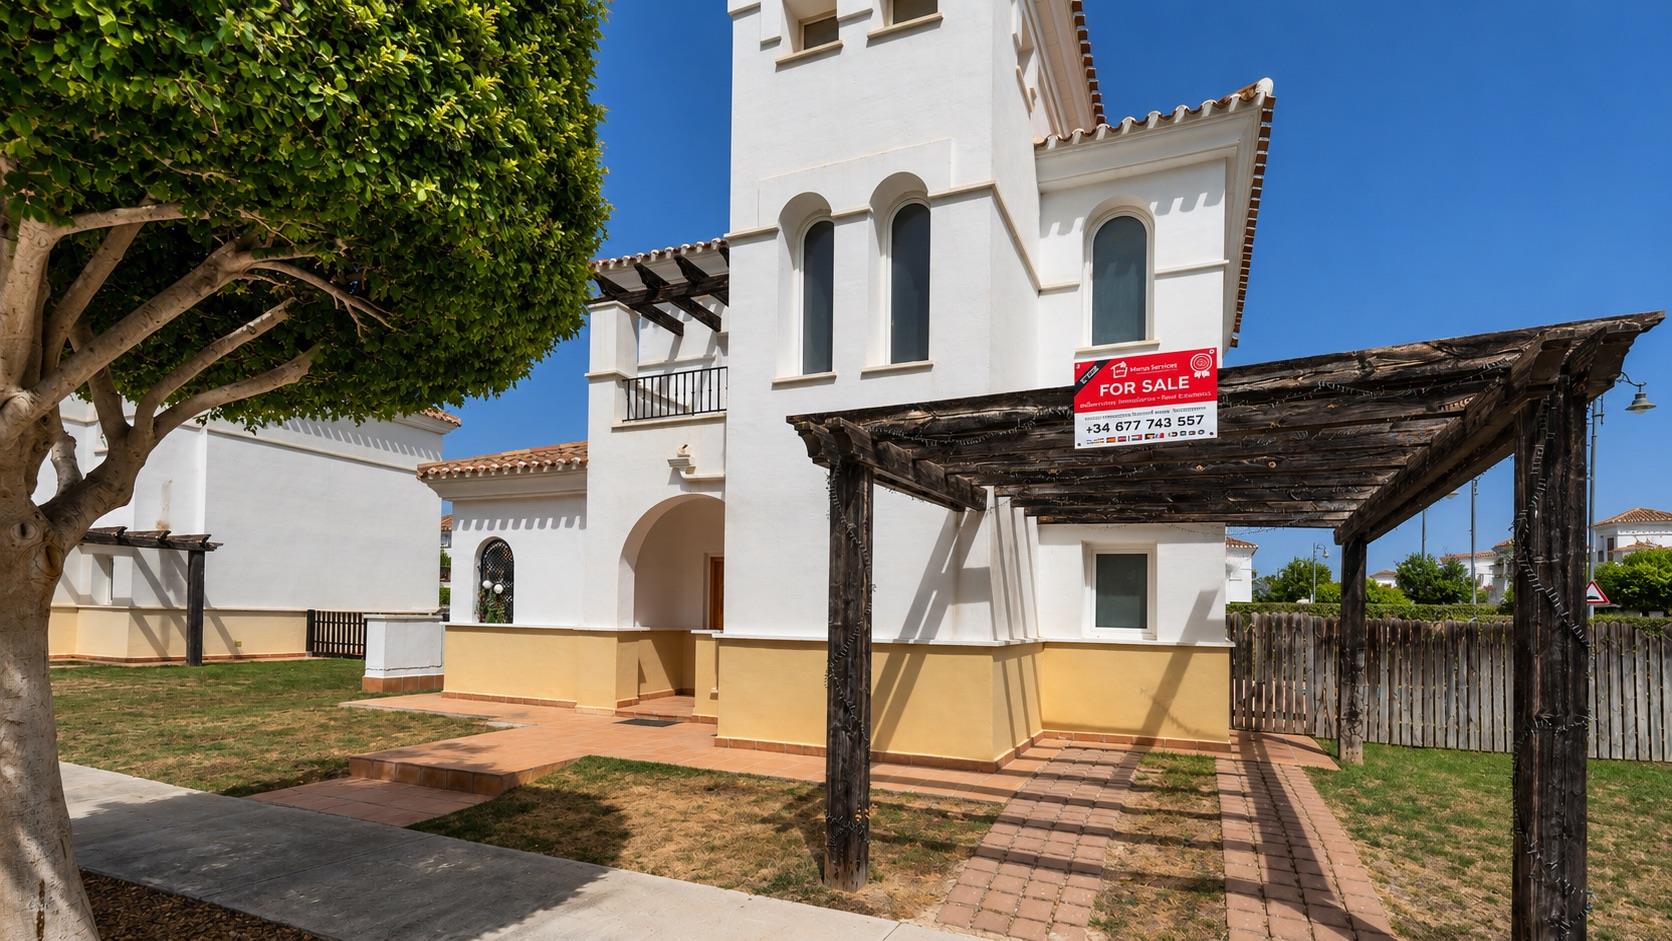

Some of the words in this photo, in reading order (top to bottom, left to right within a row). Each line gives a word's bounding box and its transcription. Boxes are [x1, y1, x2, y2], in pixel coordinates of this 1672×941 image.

[1100, 383, 1136, 397] FOR
[1142, 376, 1190, 393] SALE
[1086, 422, 1110, 434] +34
[1115, 420, 1141, 432] 677
[1146, 418, 1172, 430] 743
[1177, 415, 1205, 427] 557
